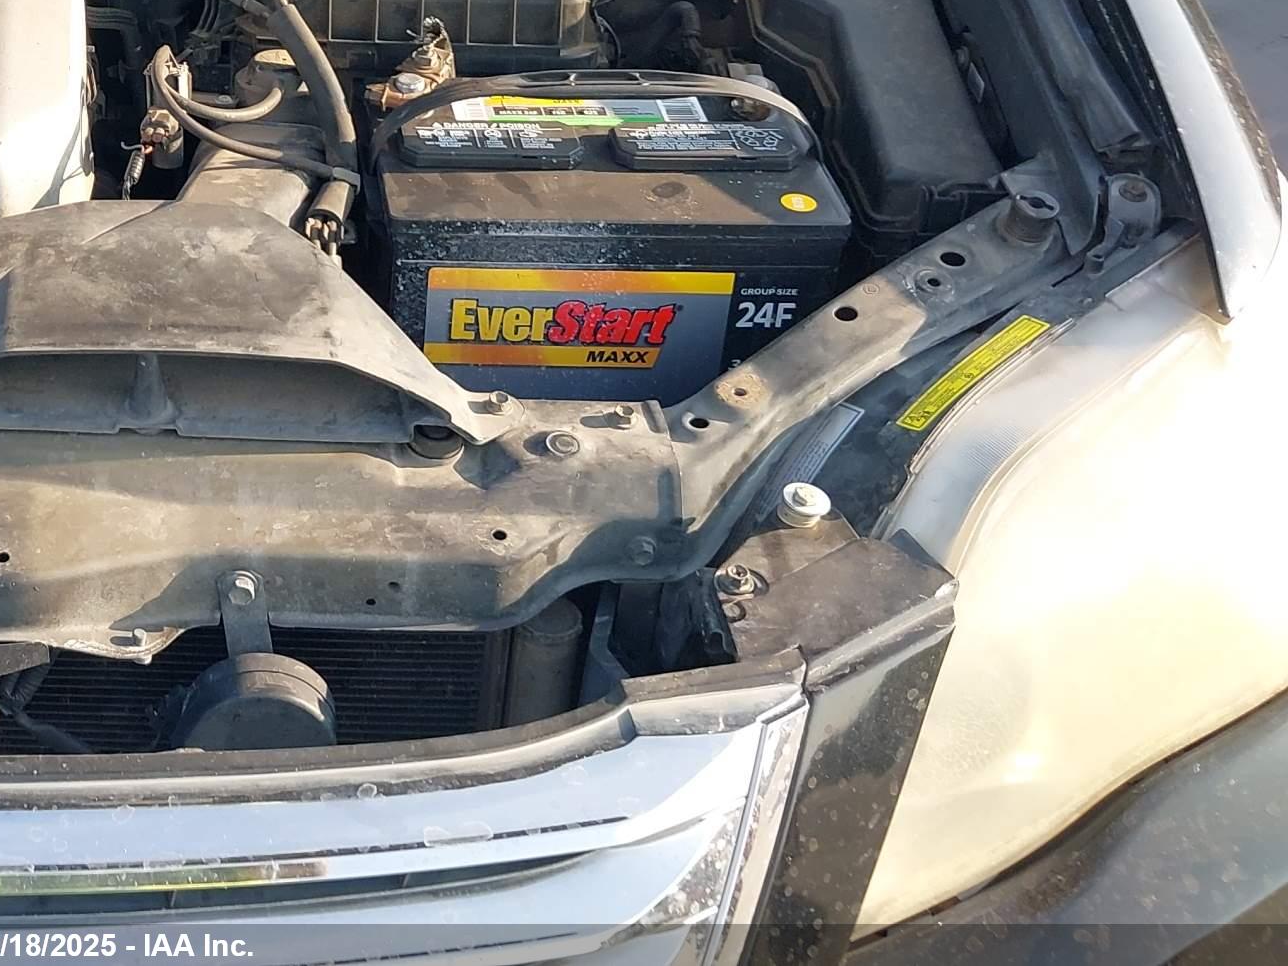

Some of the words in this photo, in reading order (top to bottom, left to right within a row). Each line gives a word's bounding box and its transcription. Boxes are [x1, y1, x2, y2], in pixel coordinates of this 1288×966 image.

[449, 298, 676, 345] EverStart
[735, 301, 797, 328] 24F
[587, 351, 648, 363] MAXX
